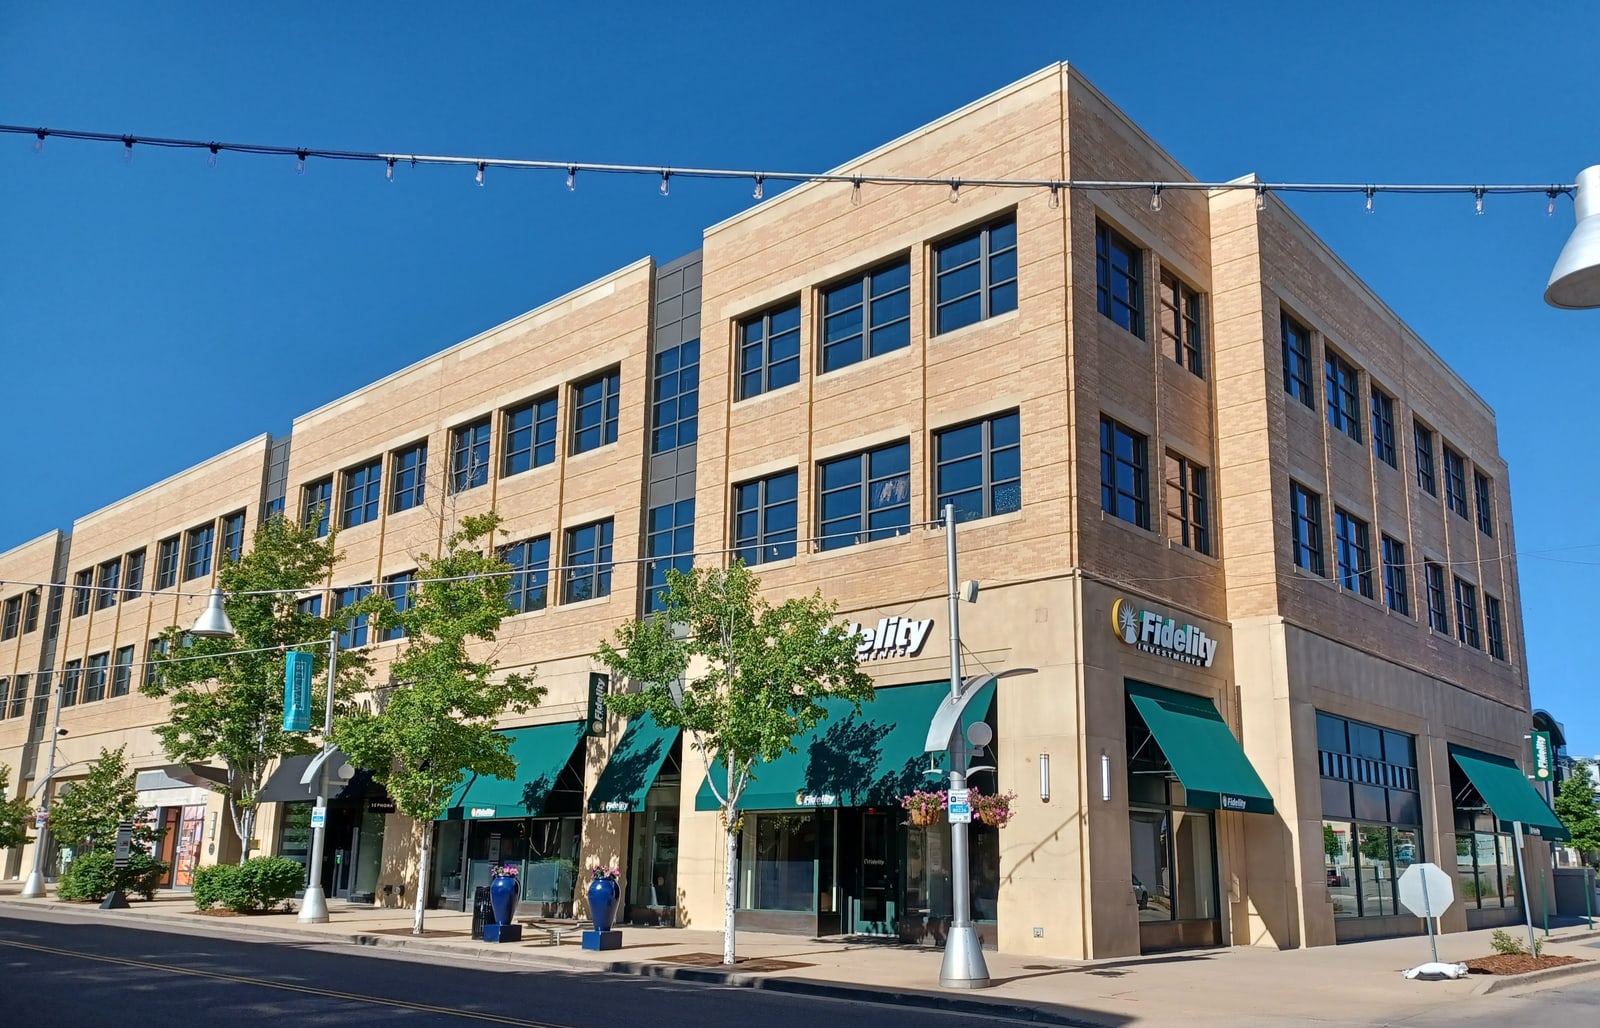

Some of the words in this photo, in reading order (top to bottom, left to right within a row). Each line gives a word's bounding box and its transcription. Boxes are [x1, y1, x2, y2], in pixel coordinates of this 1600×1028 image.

[819, 616, 932, 653] delity
[1140, 610, 1218, 668] Fidelity
[1137, 643, 1201, 667] INVESTMENTS
[594, 677, 606, 721] Fidelity
[606, 801, 629, 812] Fidelity
[803, 794, 836, 805] Fidelity
[1227, 797, 1247, 809] Fidelity
